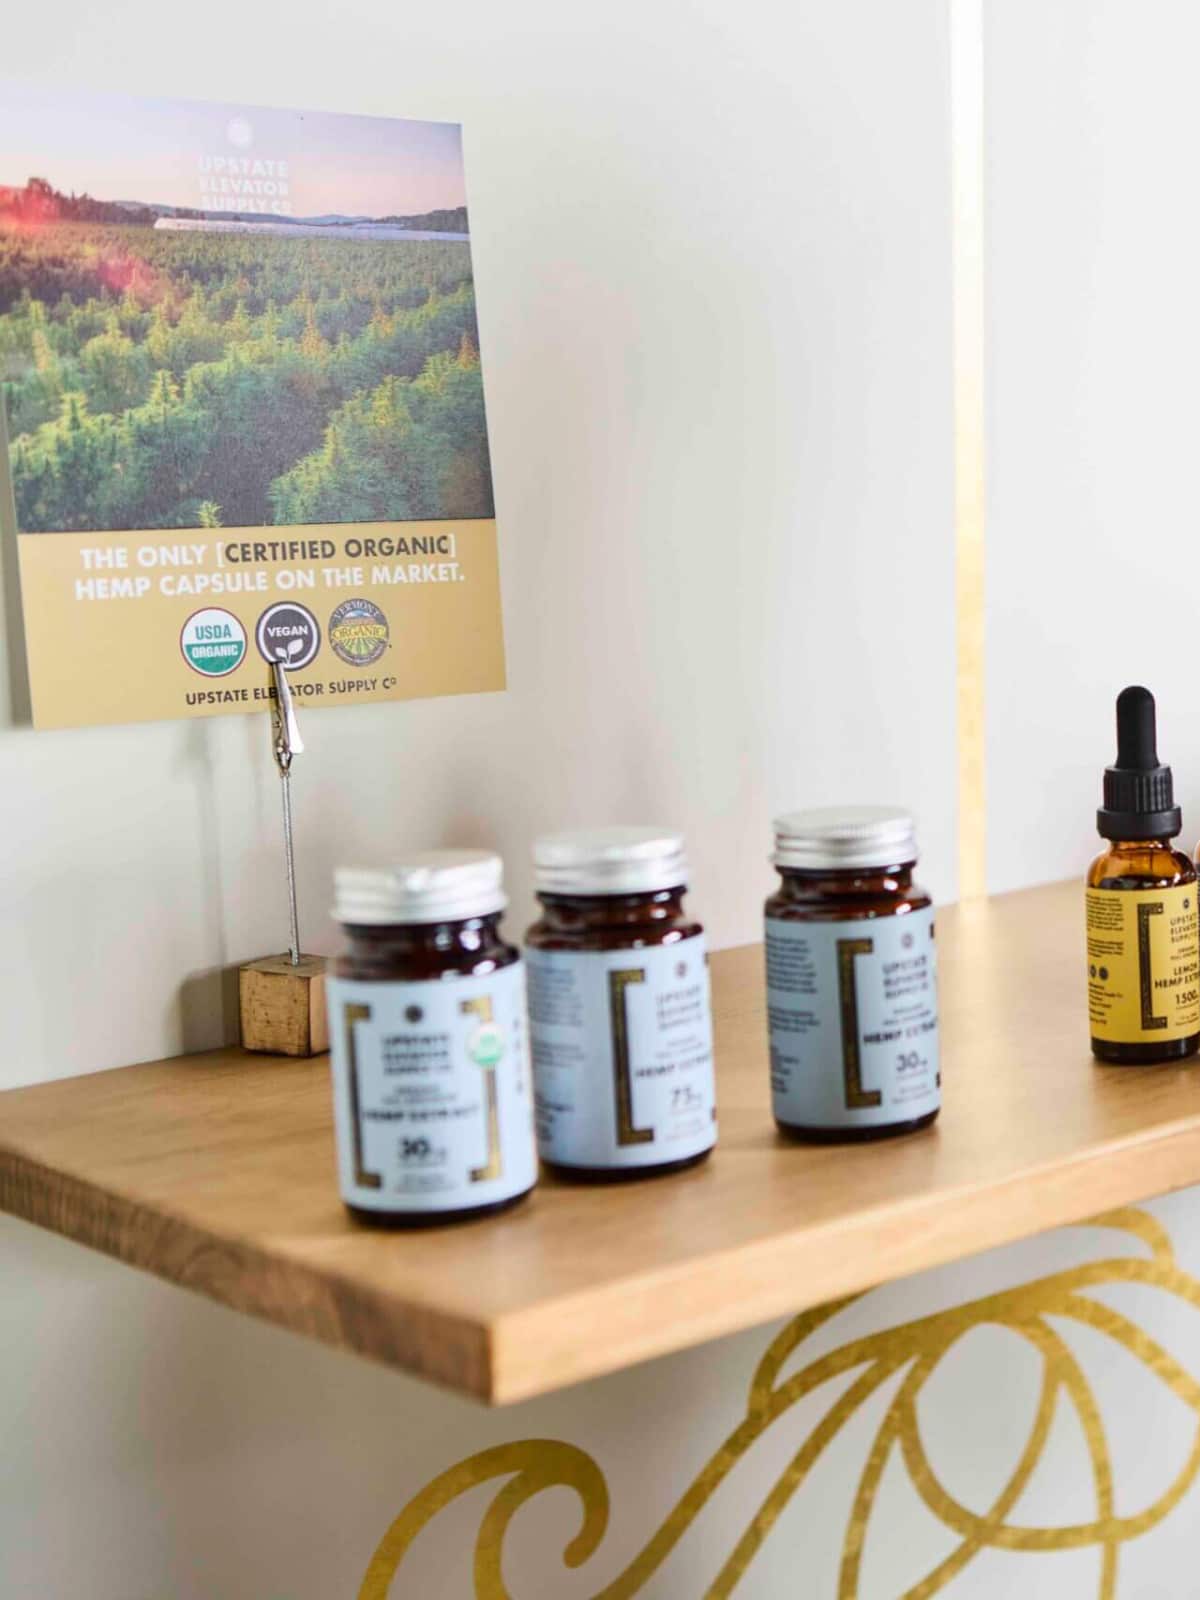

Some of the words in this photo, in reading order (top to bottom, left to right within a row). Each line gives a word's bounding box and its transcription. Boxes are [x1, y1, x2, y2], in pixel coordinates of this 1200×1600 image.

[199, 154, 288, 176] UPSTATE
[199, 175, 289, 194] ELEVATOR
[200, 194, 267, 214] SUPPLY
[79, 547, 128, 569] THE
[136, 544, 207, 567] ONLY
[75, 576, 151, 600] HEMP
[159, 571, 268, 596] CAPSULE
[275, 569, 315, 590] ON
[322, 566, 364, 588] THE
[371, 563, 465, 585] MARKET.
[195, 624, 232, 641] USDA
[266, 624, 308, 638] VEGAN
[191, 644, 238, 659] ORGANIC
[186, 688, 249, 705] UPSTATE
[253, 683, 324, 701] ELEATOR
[329, 679, 378, 695] SUPPLY
[1155, 976, 1183, 988] HEMP
